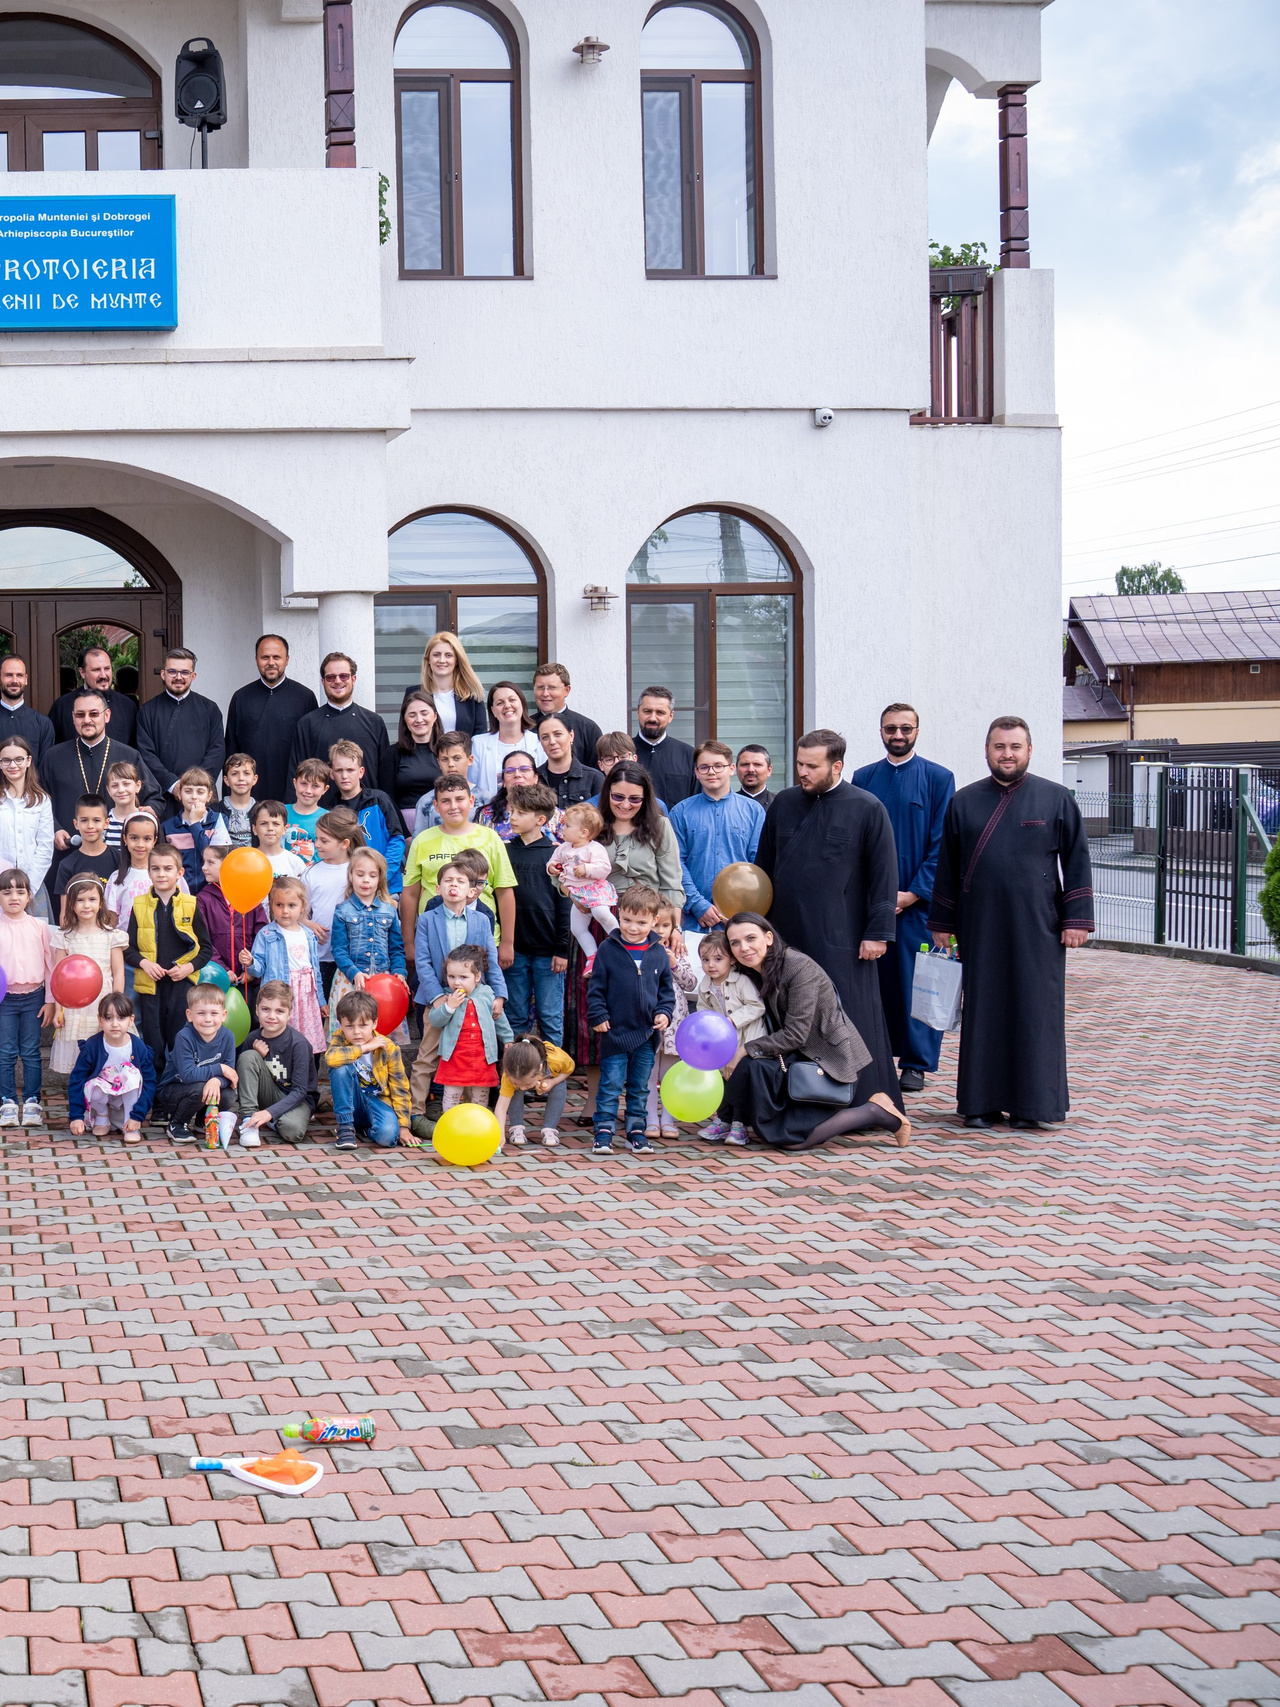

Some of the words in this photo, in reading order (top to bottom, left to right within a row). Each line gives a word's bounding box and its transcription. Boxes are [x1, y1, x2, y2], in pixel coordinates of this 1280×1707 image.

[37, 211, 89, 222] Munteniei
[103, 211, 151, 223] Dobrogei
[52, 293, 79, 310] DE
[90, 292, 162, 309] MUNTE
